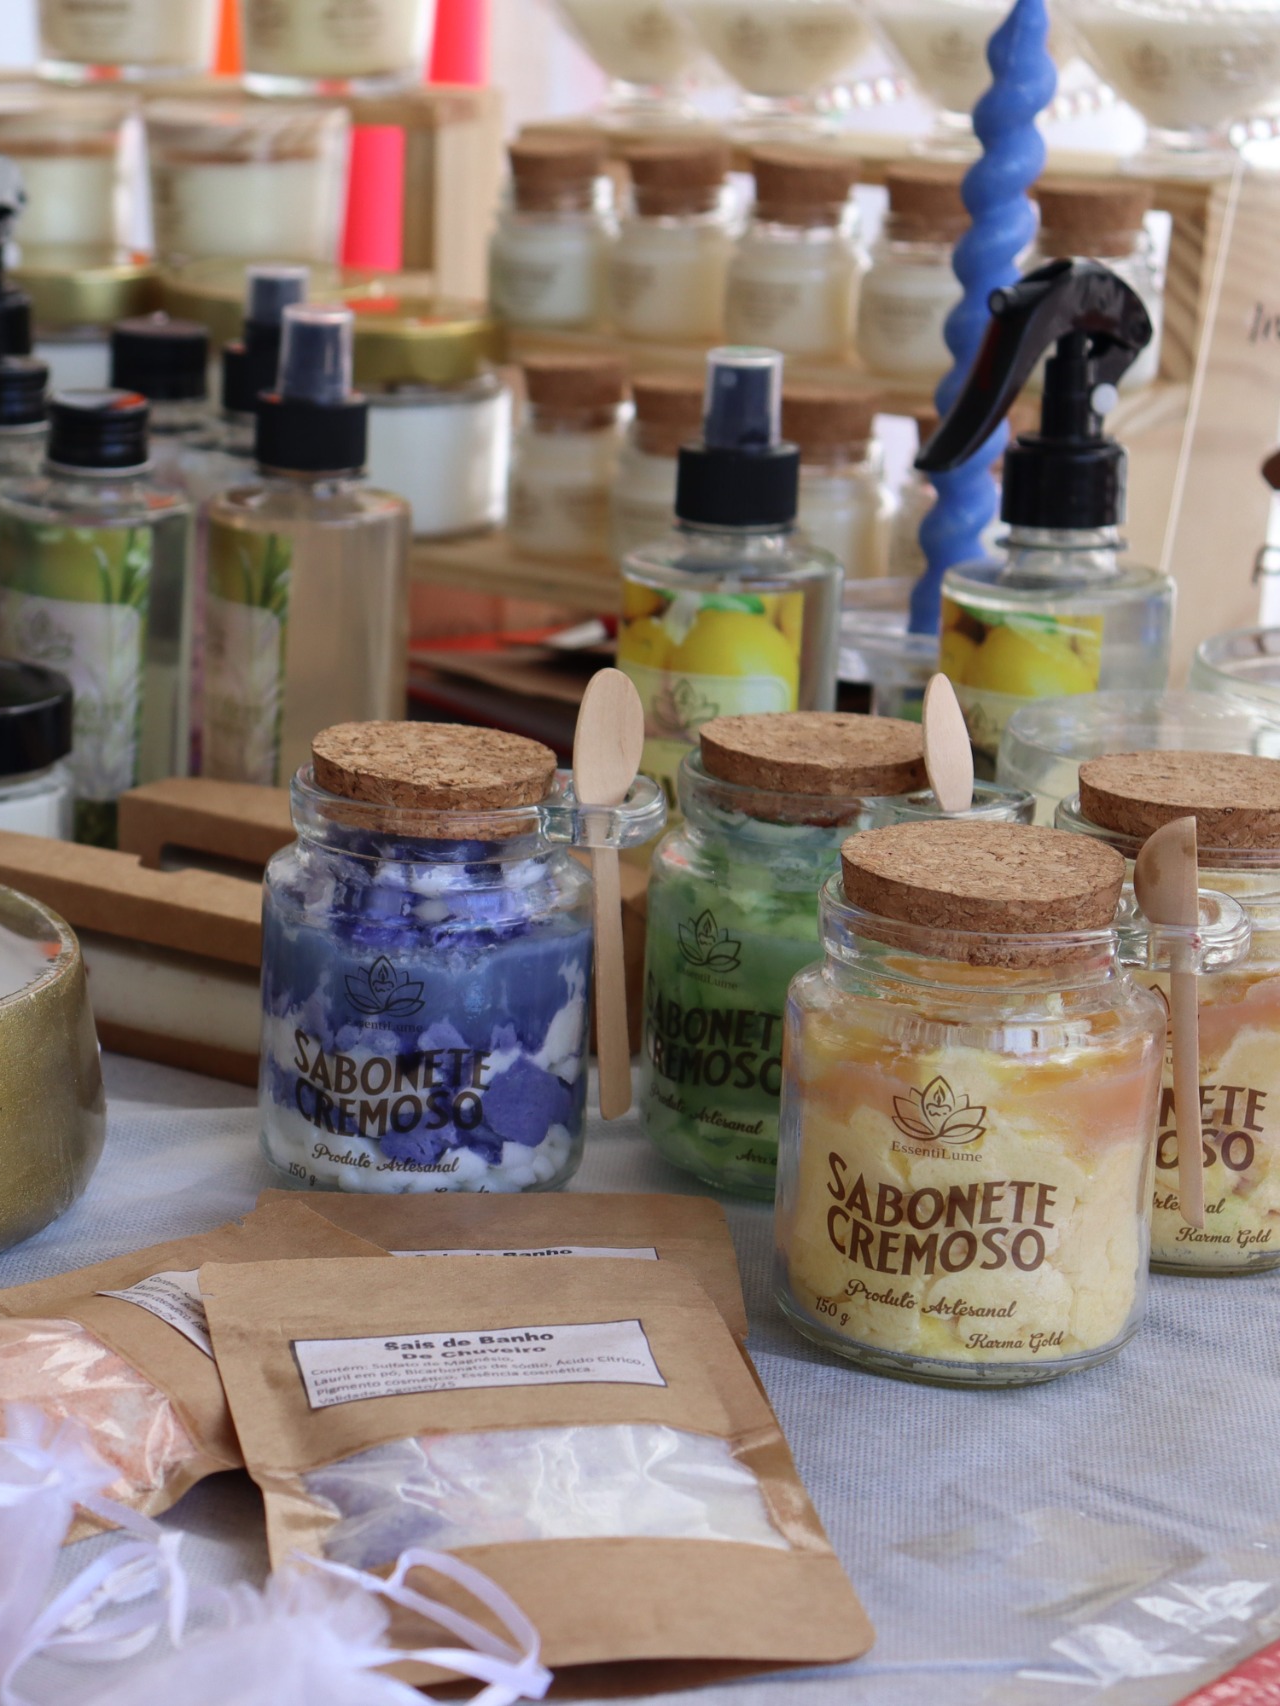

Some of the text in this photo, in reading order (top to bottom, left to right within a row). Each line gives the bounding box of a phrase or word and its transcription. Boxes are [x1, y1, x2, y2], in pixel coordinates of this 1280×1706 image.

[648, 969, 782, 1052] SABONET
[294, 1028, 491, 1096] SABONETE
[296, 1077, 483, 1139] CREMOSO
[688, 1106, 763, 1135] Artesanal
[312, 1143, 459, 1174] Produto Artesanal
[891, 1140, 983, 1163] EssentiLume
[288, 1162, 307, 1179] 150
[826, 1151, 1058, 1230] SABONETE
[827, 1205, 1046, 1276] CREMOSO
[1175, 1227, 1272, 1249] Karma Gold
[815, 1296, 851, 1326] 150 g
[845, 1278, 1017, 1318] Produto Artesanal
[384, 1332, 554, 1351] Sais de Banho
[441, 1345, 546, 1358] Chuveiro
[965, 1330, 1064, 1353] Karma Gold
[314, 1374, 351, 1387] Lauril
[405, 1363, 487, 1375] Bicarbonato
[491, 1362, 509, 1370] de
[372, 1361, 419, 1370] Sulfato
[462, 1371, 519, 1379] Essência
